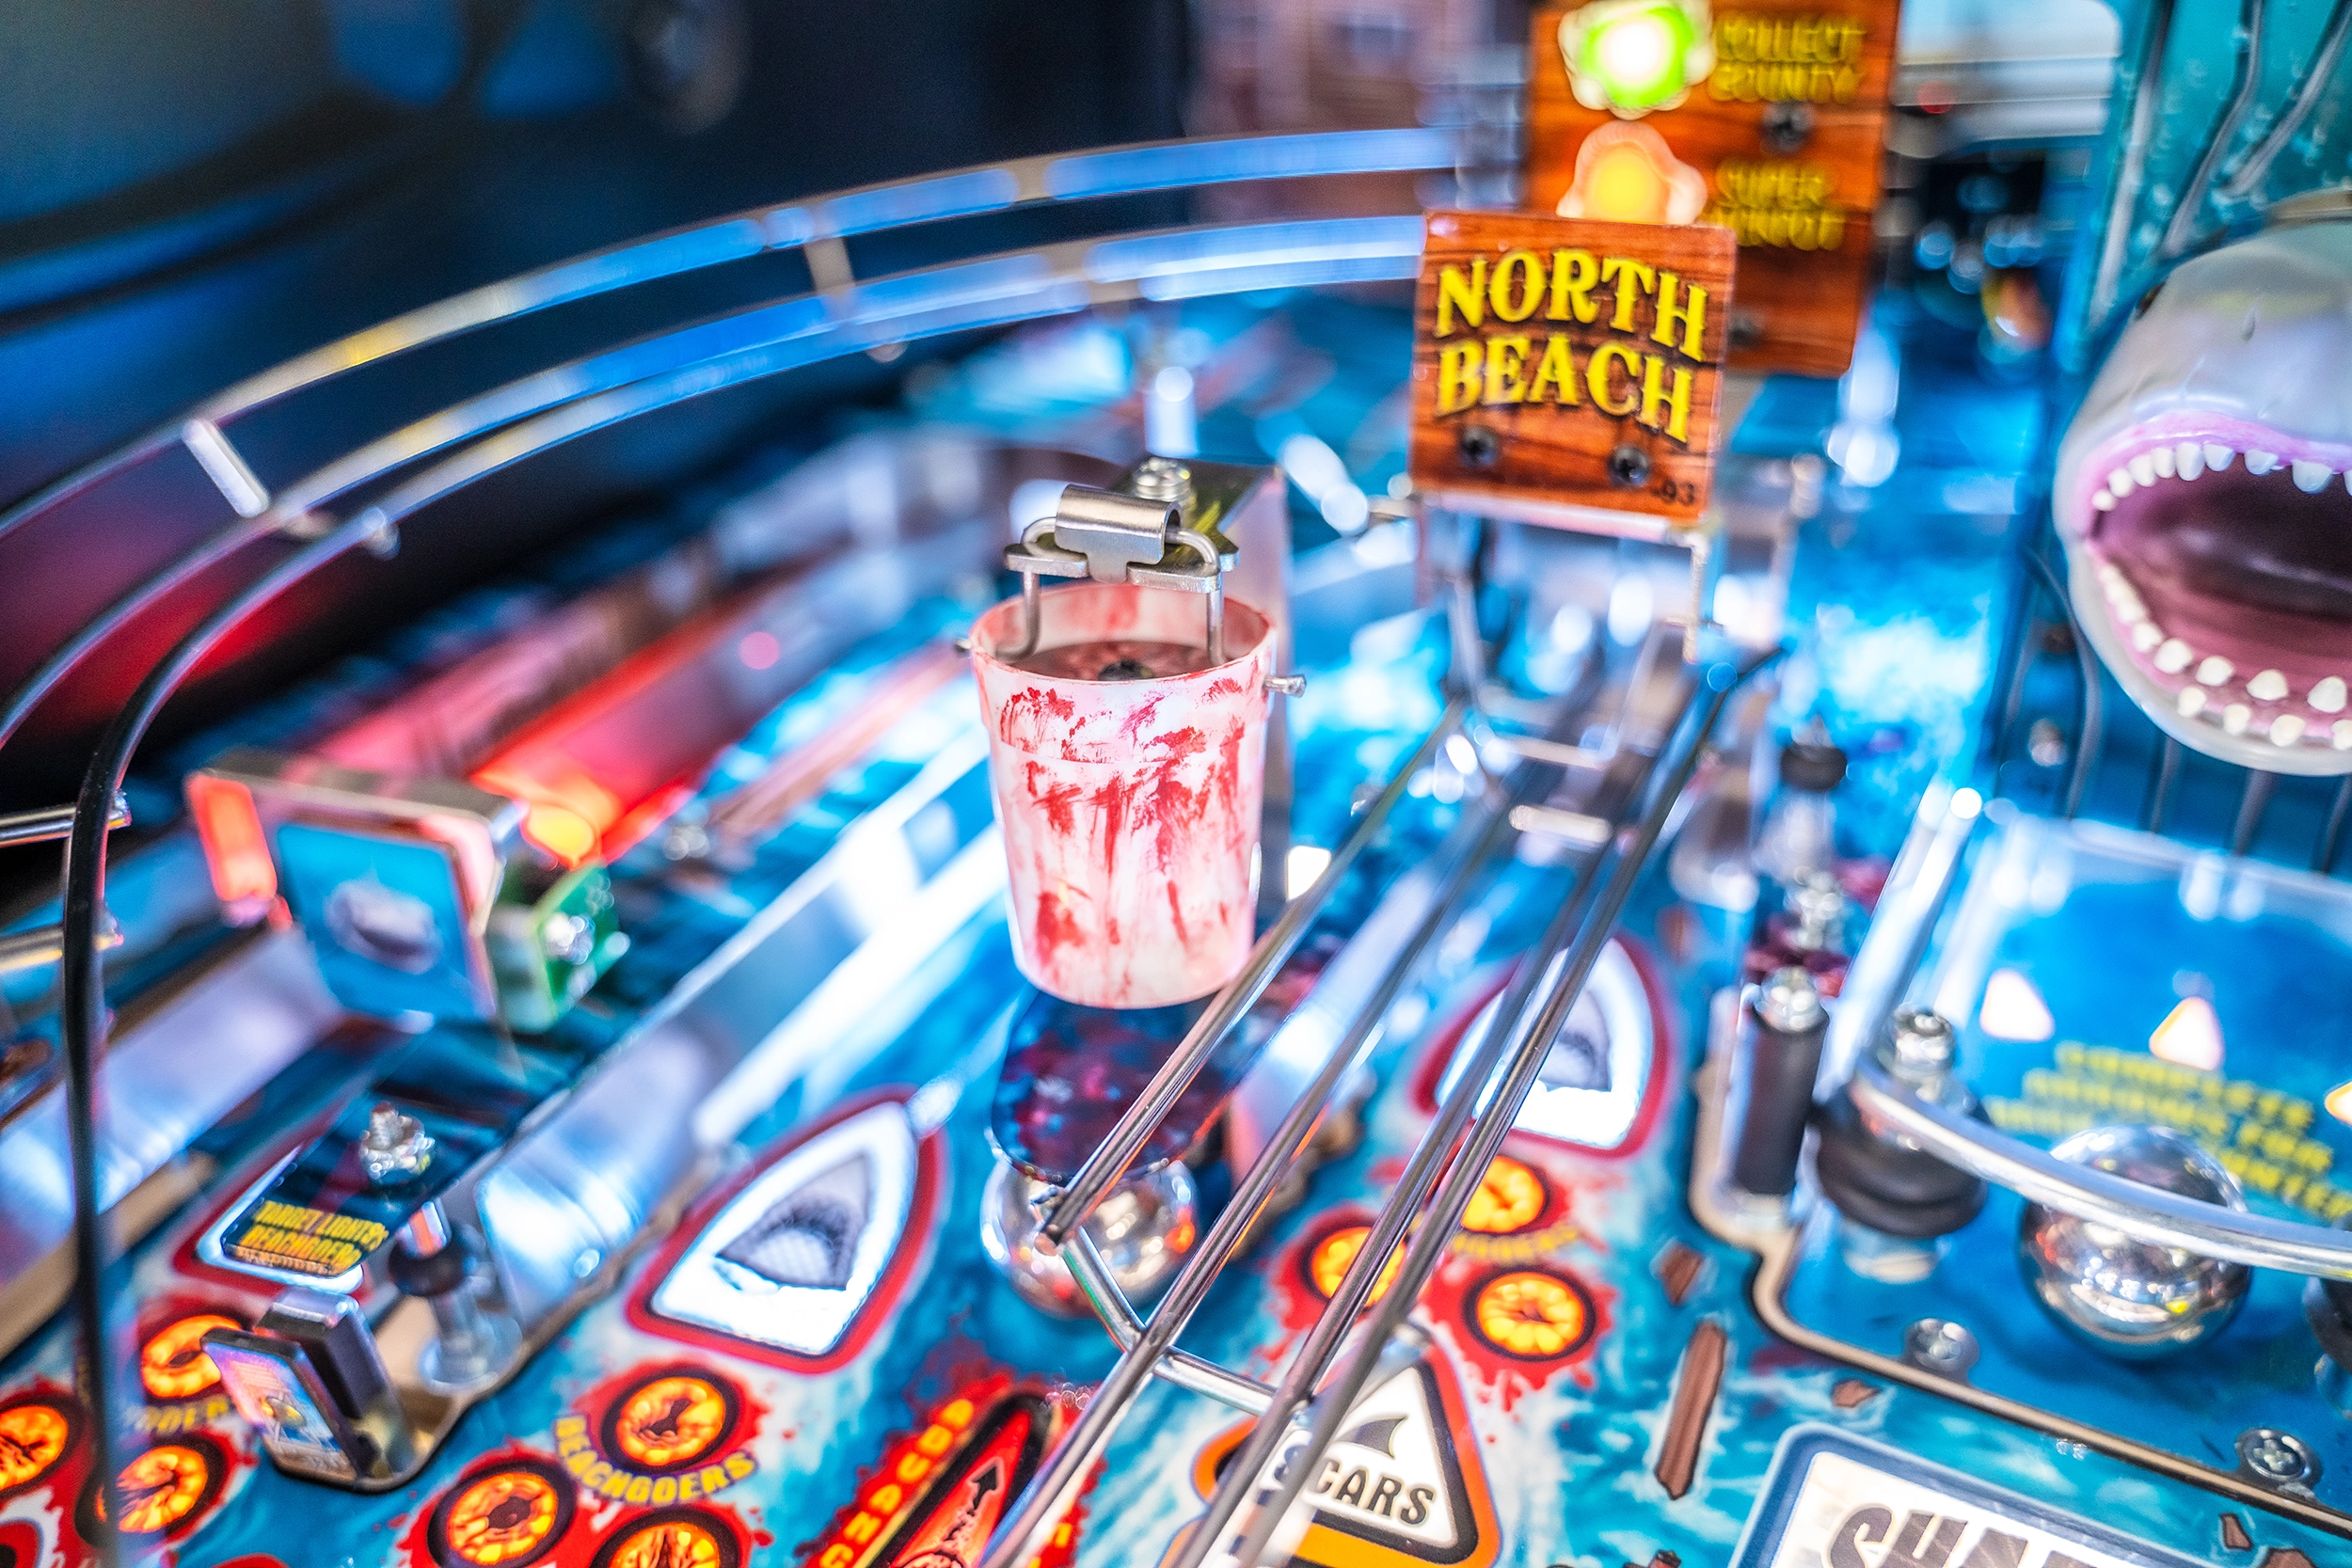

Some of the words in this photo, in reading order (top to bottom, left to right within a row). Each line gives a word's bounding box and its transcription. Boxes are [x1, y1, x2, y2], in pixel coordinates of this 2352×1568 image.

[1435, 247, 1708, 362] NORTH
[1435, 332, 1692, 444] BEACH
[554, 1414, 756, 1505] BEACHGOERS
